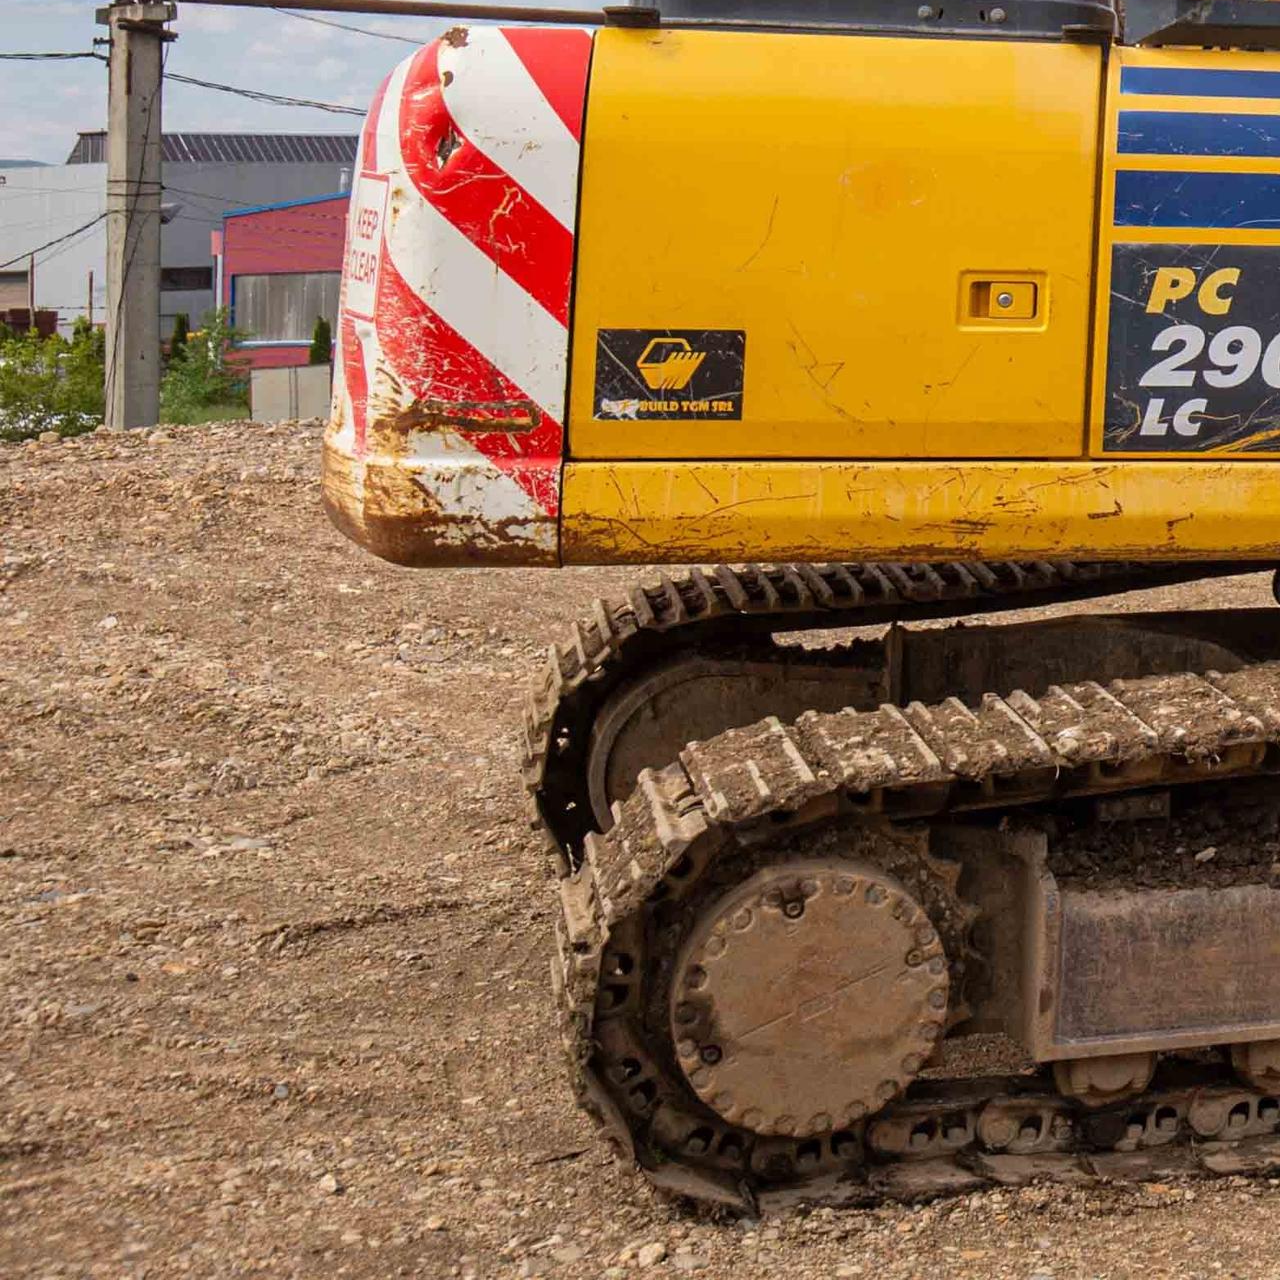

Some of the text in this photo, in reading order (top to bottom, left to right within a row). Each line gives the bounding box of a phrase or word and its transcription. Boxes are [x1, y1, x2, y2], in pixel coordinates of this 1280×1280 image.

[357, 208, 379, 240] KEEP
[1145, 267, 1242, 315] PC
[640, 400, 679, 412] BUILD
[711, 400, 734, 412] SRL
[1139, 398, 1208, 436] LC
